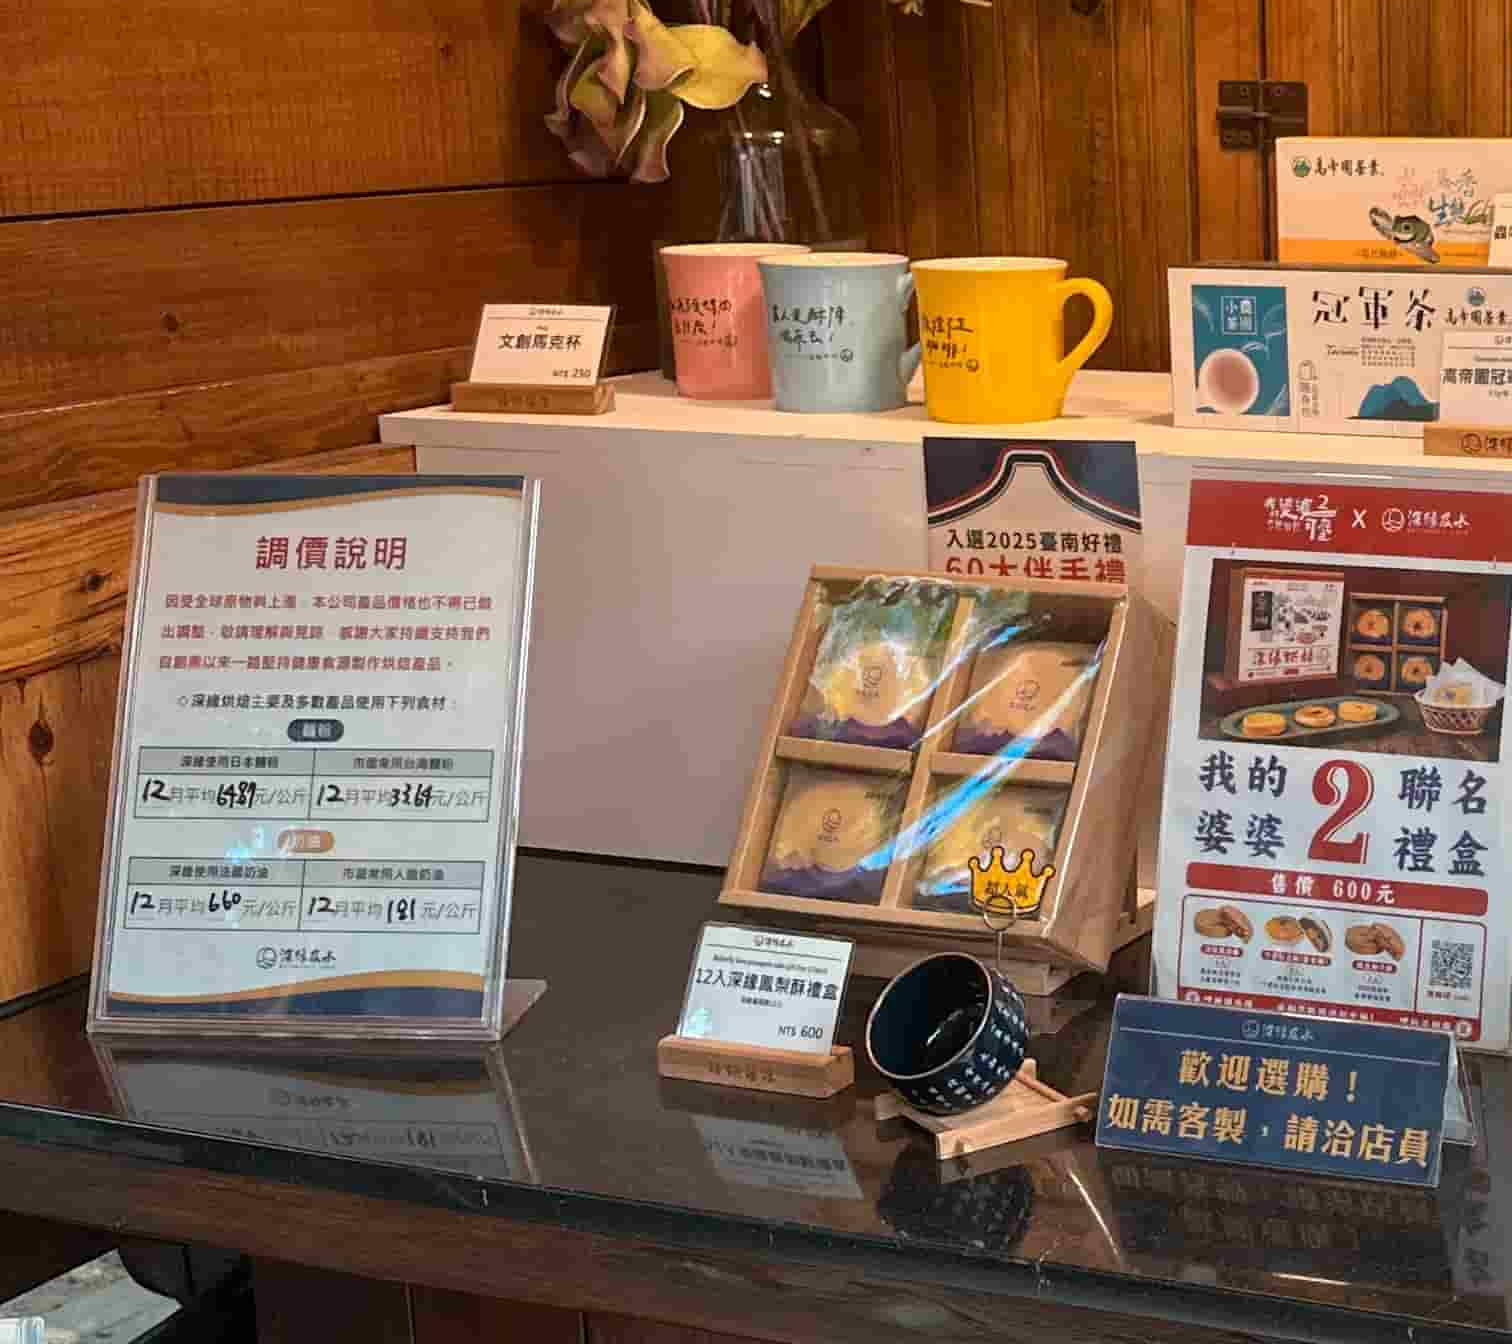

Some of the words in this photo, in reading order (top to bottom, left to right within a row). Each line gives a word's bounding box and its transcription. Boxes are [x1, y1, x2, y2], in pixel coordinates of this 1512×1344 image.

[1312, 286, 1436, 331] 冠軍茶
[498, 333, 583, 351] 文創馬克杯
[255, 535, 408, 570] 調價說明
[946, 529, 1122, 553] 入選2025臺南好禮
[1200, 750, 1286, 797] 我的
[1397, 767, 1488, 814] 聯名
[1194, 810, 1285, 859] 婆婆
[1308, 759, 1375, 864] 2
[1393, 827, 1488, 877] 禮盒
[1333, 879, 1395, 904] 600元
[778, 1026, 796, 1037] NT$
[801, 1026, 823, 1039] 600
[1179, 1051, 1359, 1103] 歡迎選購！
